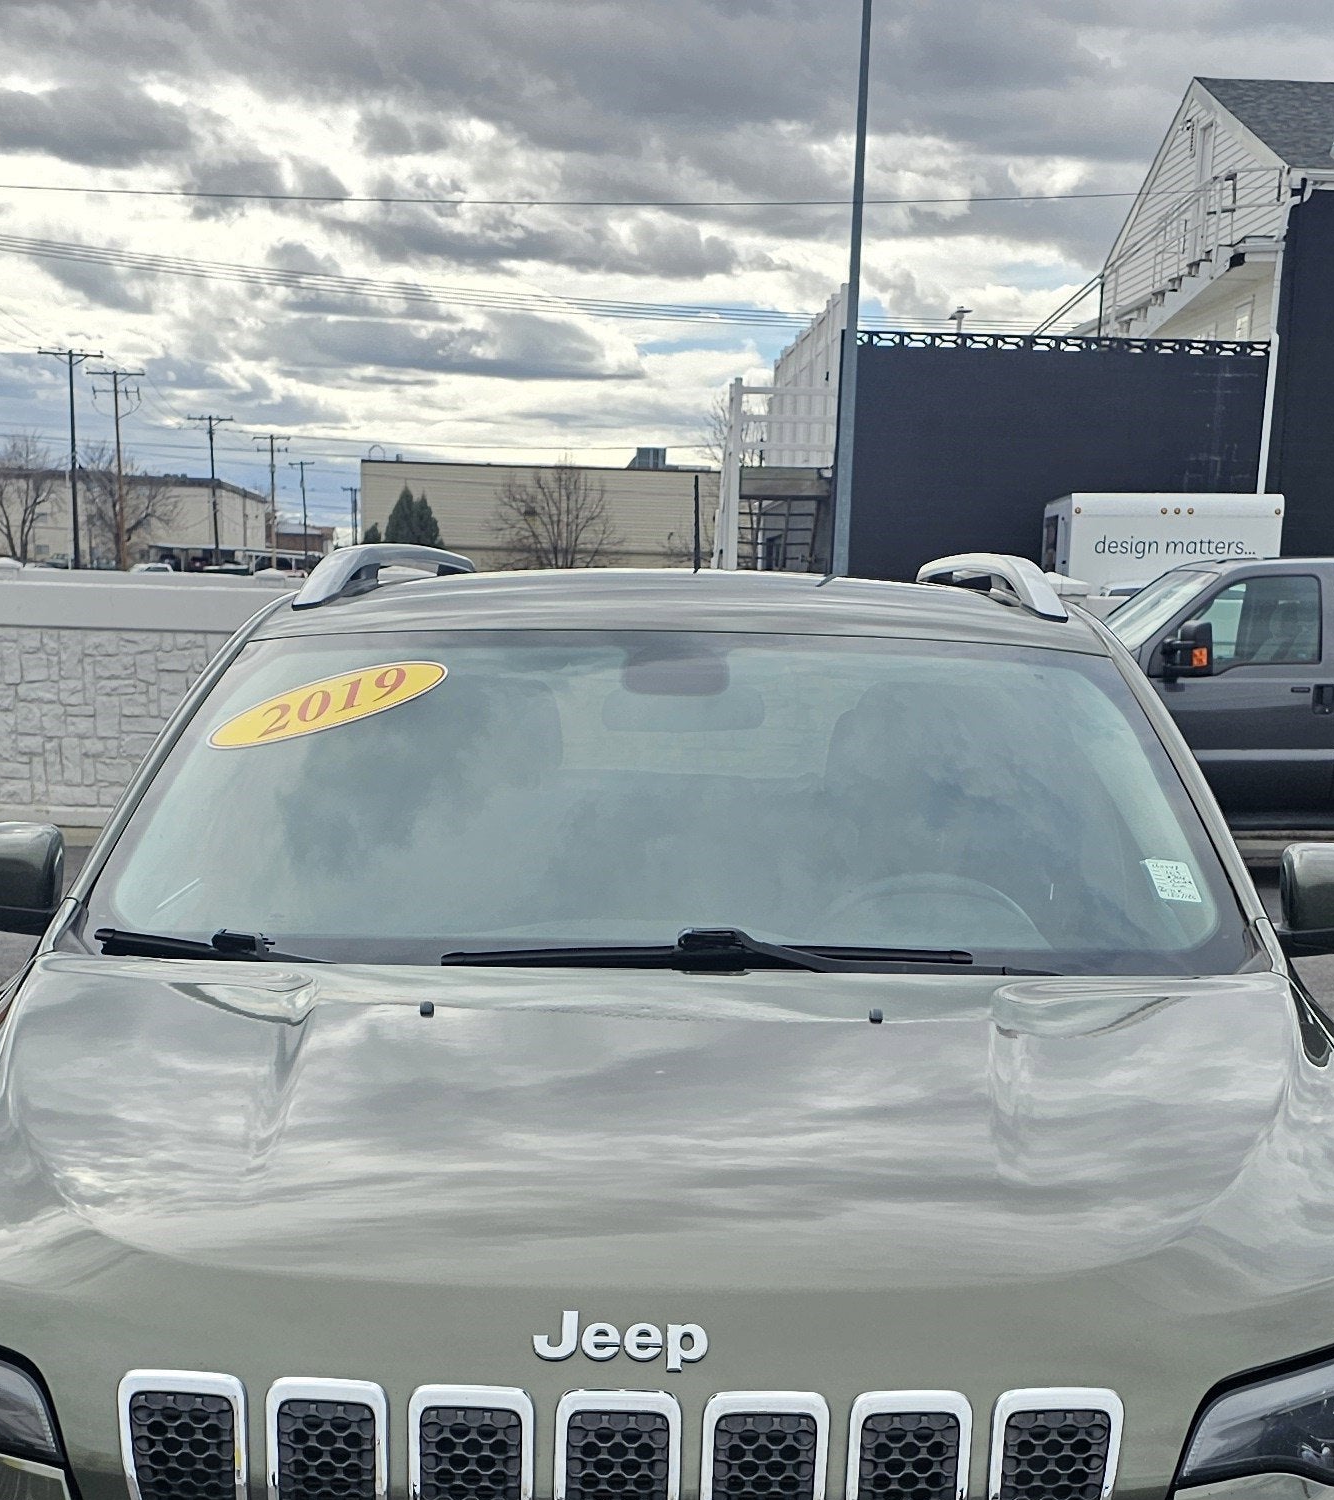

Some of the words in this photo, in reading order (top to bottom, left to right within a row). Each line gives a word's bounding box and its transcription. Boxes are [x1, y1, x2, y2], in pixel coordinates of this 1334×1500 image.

[1094, 534, 1159, 559] design
[1165, 537, 1256, 556] matters...
[257, 667, 407, 739] 2019
[532, 1310, 710, 1374] Jeep
